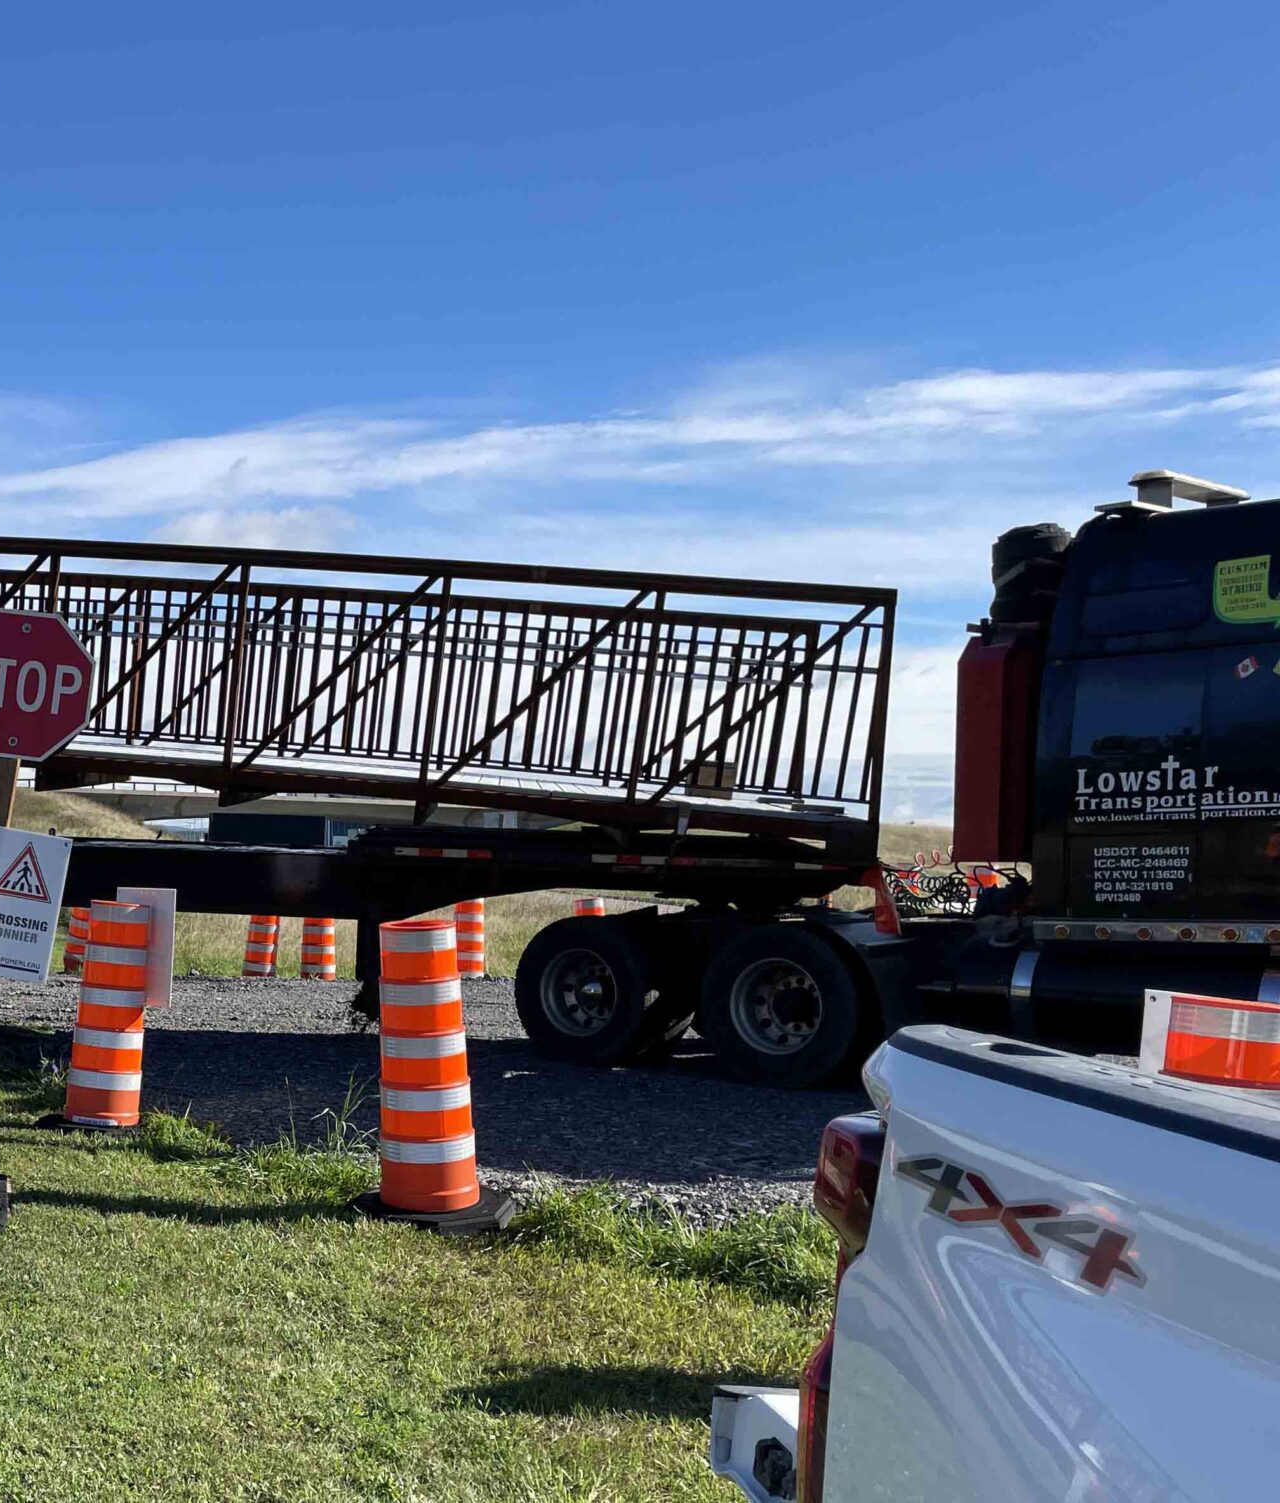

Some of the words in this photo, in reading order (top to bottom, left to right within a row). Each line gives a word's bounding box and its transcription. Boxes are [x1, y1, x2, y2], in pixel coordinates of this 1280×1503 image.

[1219, 561, 1268, 576] CUSTOM
[1076, 755, 1219, 793] Lowstar
[1075, 785, 1270, 813] Transportation
[1093, 847, 1138, 857] USDOT
[1094, 870, 1111, 880] KY
[1113, 870, 1138, 879] KYU
[1141, 869, 1185, 879] 113620
[1094, 882, 1112, 891] PQ
